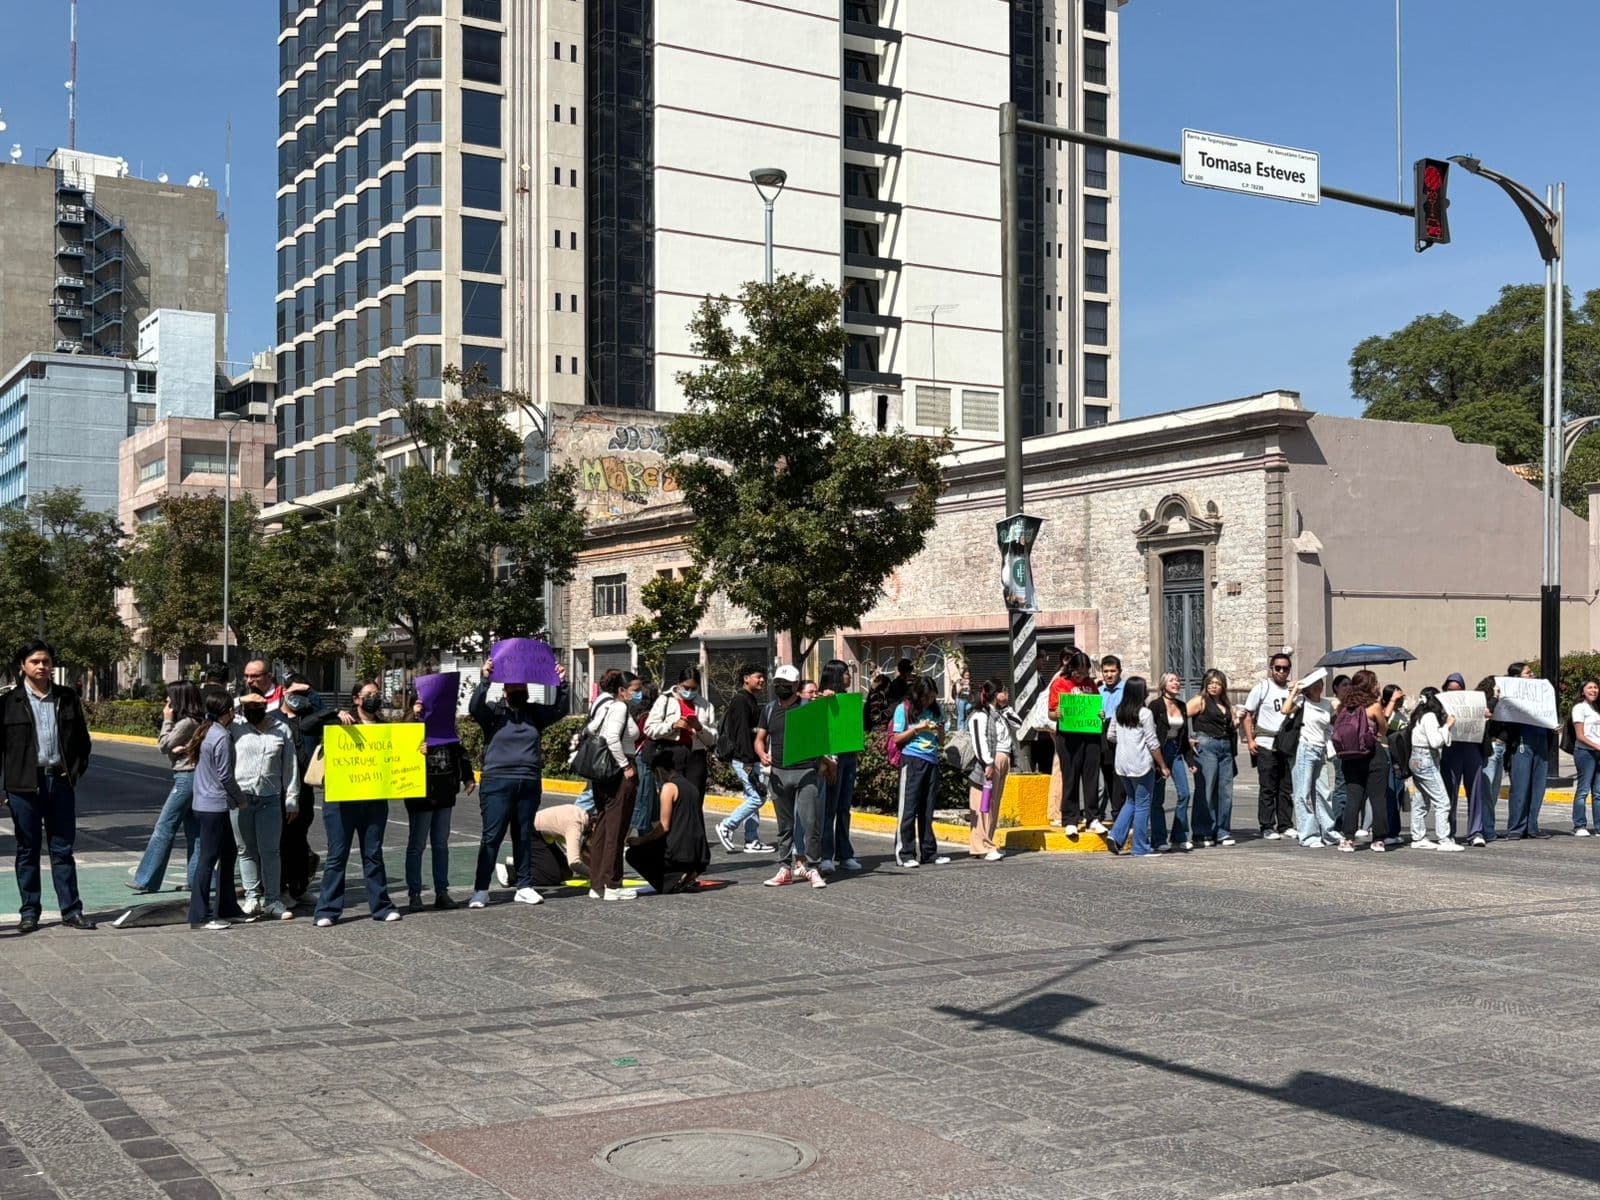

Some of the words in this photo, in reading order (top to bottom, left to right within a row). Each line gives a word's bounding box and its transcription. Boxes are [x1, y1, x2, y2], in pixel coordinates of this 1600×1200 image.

[1198, 151, 1252, 175] Tomasa
[1256, 161, 1306, 184] Esteves
[368, 741, 393, 751] VIOLA
[333, 755, 378, 767] DESTRUYE
